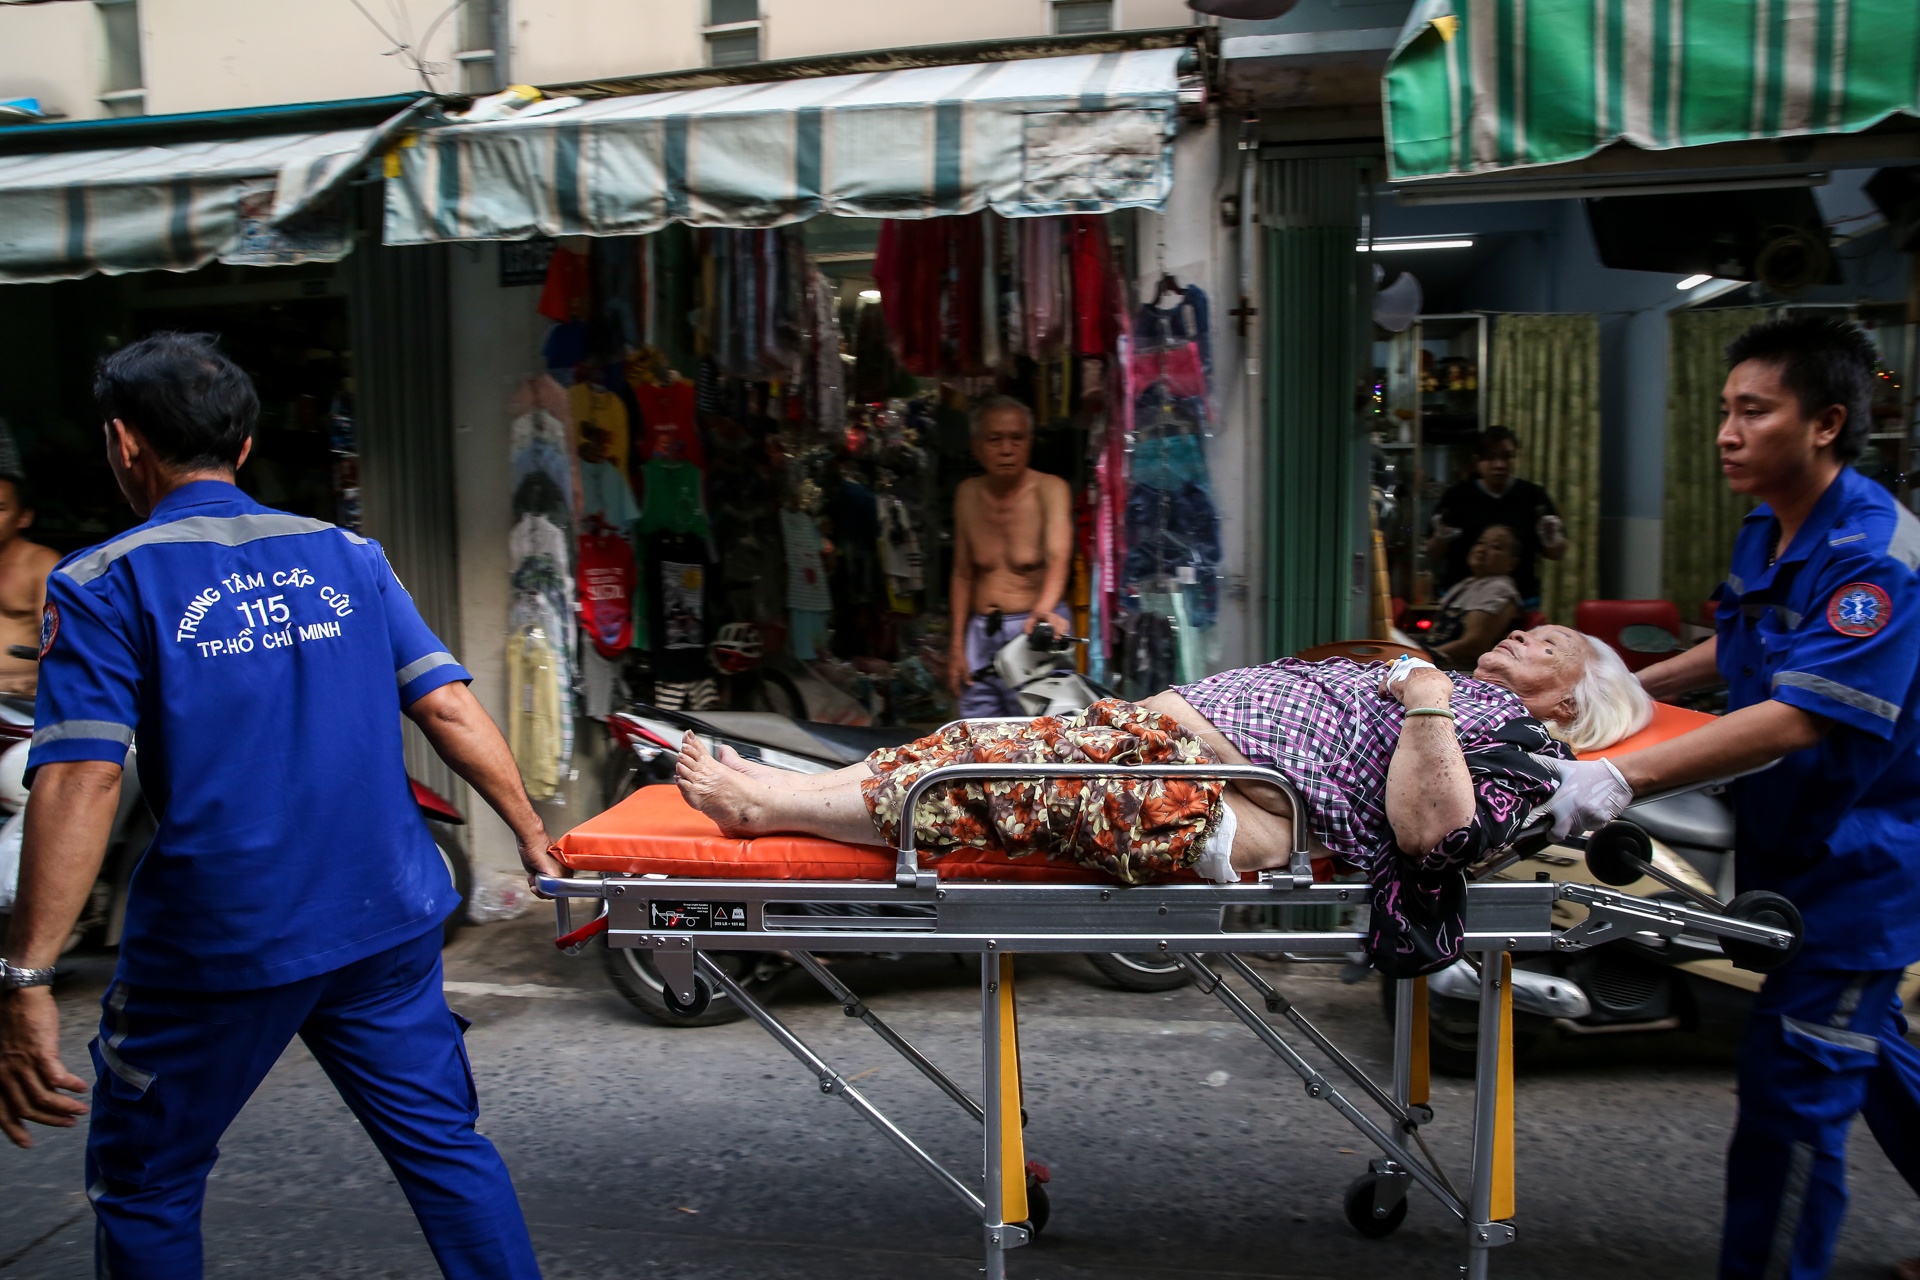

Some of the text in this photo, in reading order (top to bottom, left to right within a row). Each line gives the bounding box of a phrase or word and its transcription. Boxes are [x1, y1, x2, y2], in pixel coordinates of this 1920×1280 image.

[177, 567, 353, 643] TRUNG TÂM CẤP CỨU
[236, 594, 290, 628] 115
[196, 620, 341, 658] TP.HỒ CHÍ MINH
